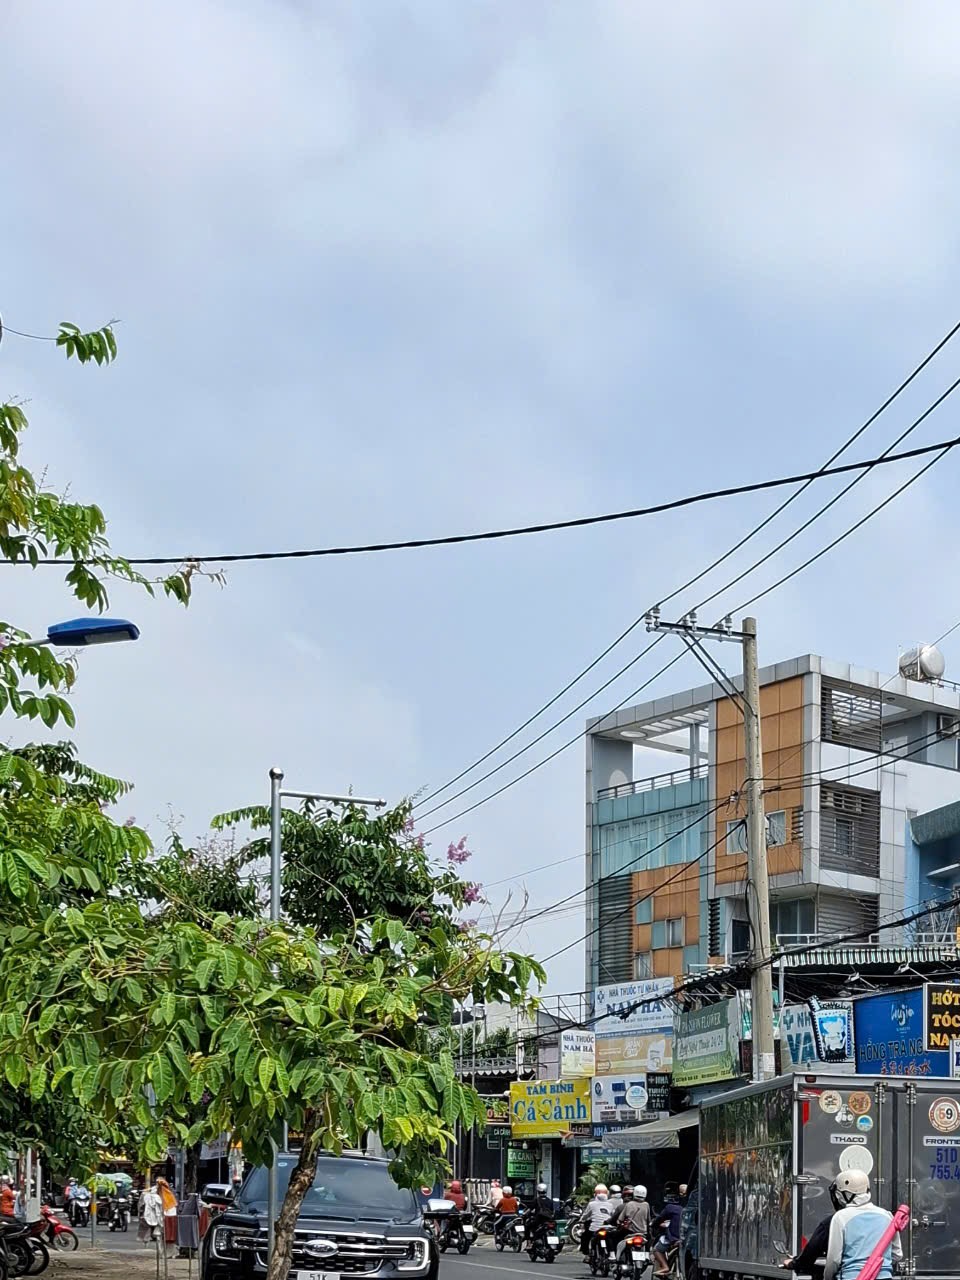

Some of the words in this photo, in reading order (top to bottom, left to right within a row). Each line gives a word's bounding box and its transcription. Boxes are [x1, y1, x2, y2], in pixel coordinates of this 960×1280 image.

[527, 1085, 547, 1095] TAM
[514, 1100, 536, 1121] Cá
[834, 1135, 865, 1143] THACO
[936, 1148, 958, 1163] 51D
